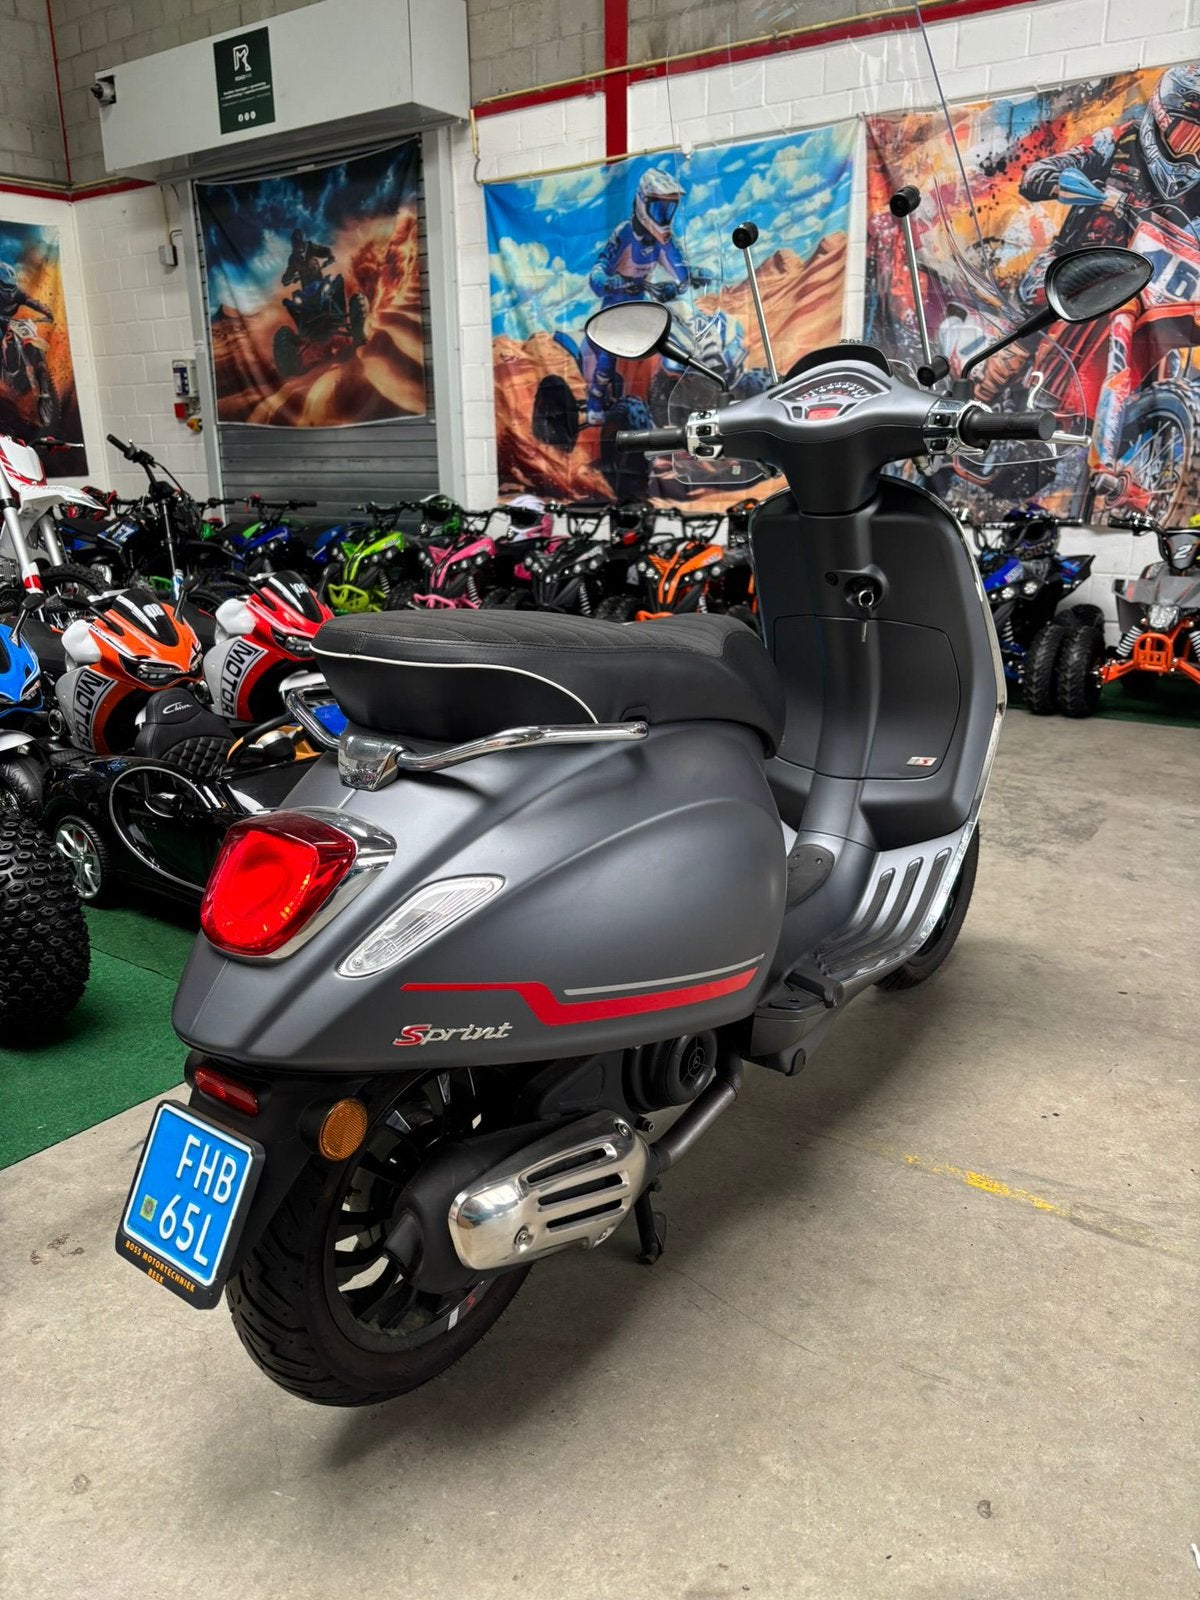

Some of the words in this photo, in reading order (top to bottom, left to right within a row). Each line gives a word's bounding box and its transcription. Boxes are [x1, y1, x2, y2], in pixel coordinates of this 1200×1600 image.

[1173, 544, 1193, 560] 2
[392, 1022, 513, 1046] Sprint
[176, 1134, 236, 1204] FHB
[159, 1194, 209, 1266] 65L
[125, 1240, 141, 1256] BOSS
[142, 1251, 196, 1293] MOTORTECHNIEK
[147, 1268, 164, 1284] BEEK
